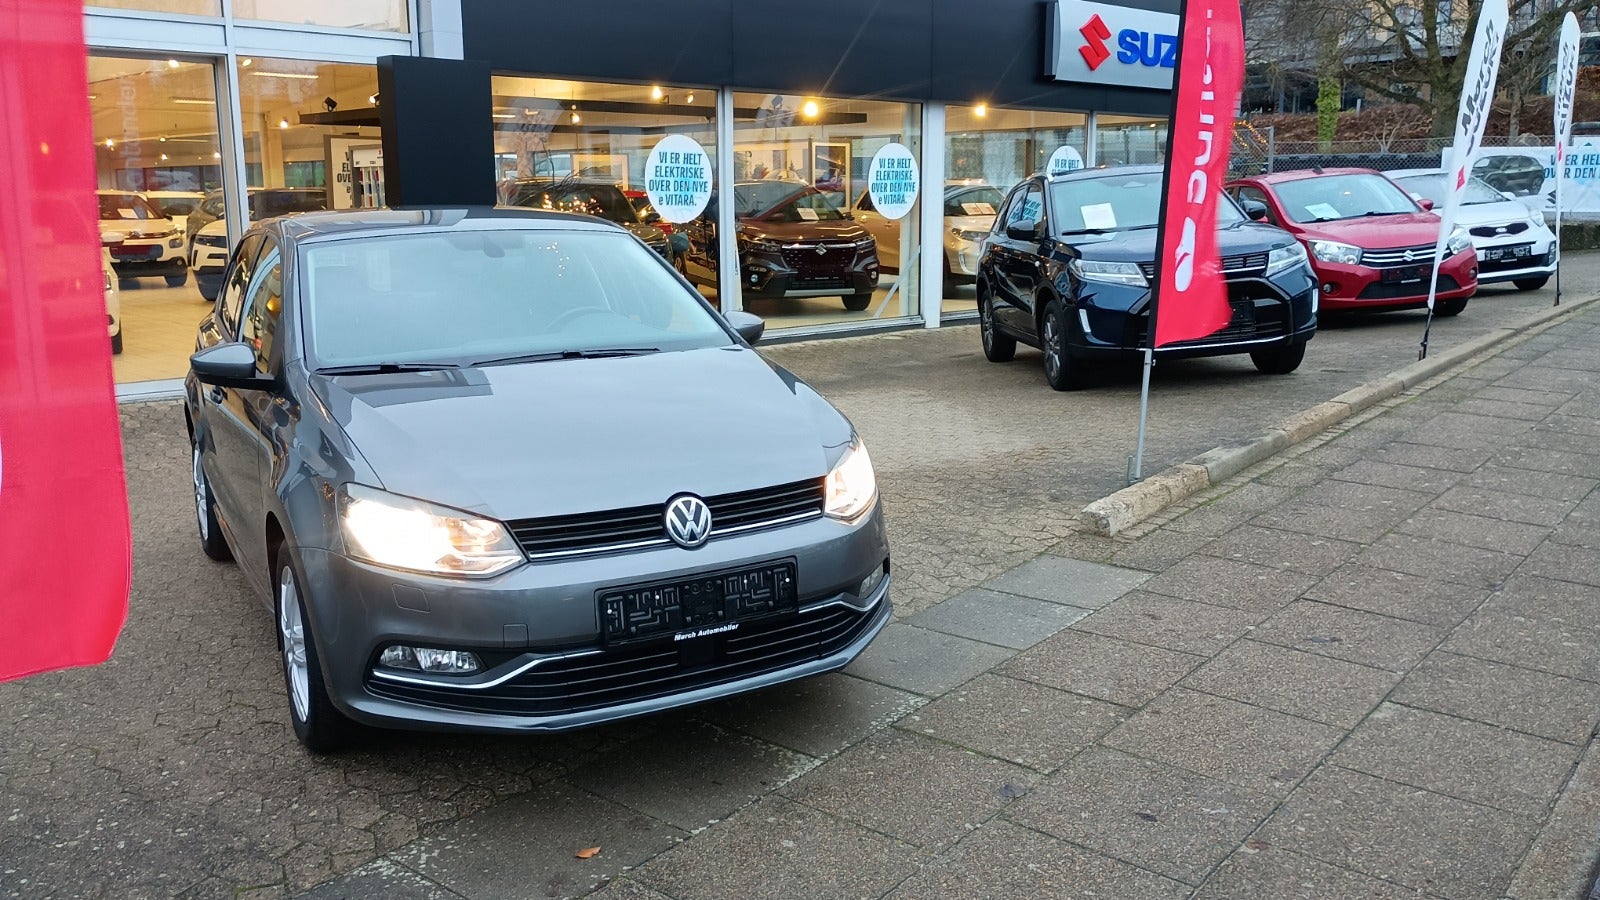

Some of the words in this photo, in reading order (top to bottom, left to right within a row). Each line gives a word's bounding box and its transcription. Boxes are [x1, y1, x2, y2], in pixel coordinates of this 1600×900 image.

[659, 152, 668, 164] VI
[670, 152, 680, 164] ER
[683, 153, 702, 165] HELT
[879, 158, 885, 169] VI
[887, 158, 895, 169] ER
[897, 158, 911, 169] HELT
[1565, 154, 1578, 166] ER
[337, 173, 351, 182] OVE
[655, 166, 704, 178] ELEKTRISKE
[876, 170, 912, 181] ELEKTRISKE
[1543, 167, 1571, 179] OVR
[1574, 167, 1597, 179] DEN
[649, 179, 671, 192] OVER
[674, 180, 690, 192] DEN
[692, 181, 708, 193] NYE
[872, 183, 888, 192] OVER
[890, 182, 902, 192] DEN
[904, 182, 916, 192] NYE
[658, 197, 664, 206] e
[665, 194, 697, 206] VITARA.
[878, 196, 882, 204] e
[674, 631, 697, 642] March
[697, 623, 740, 638] Automobiler
